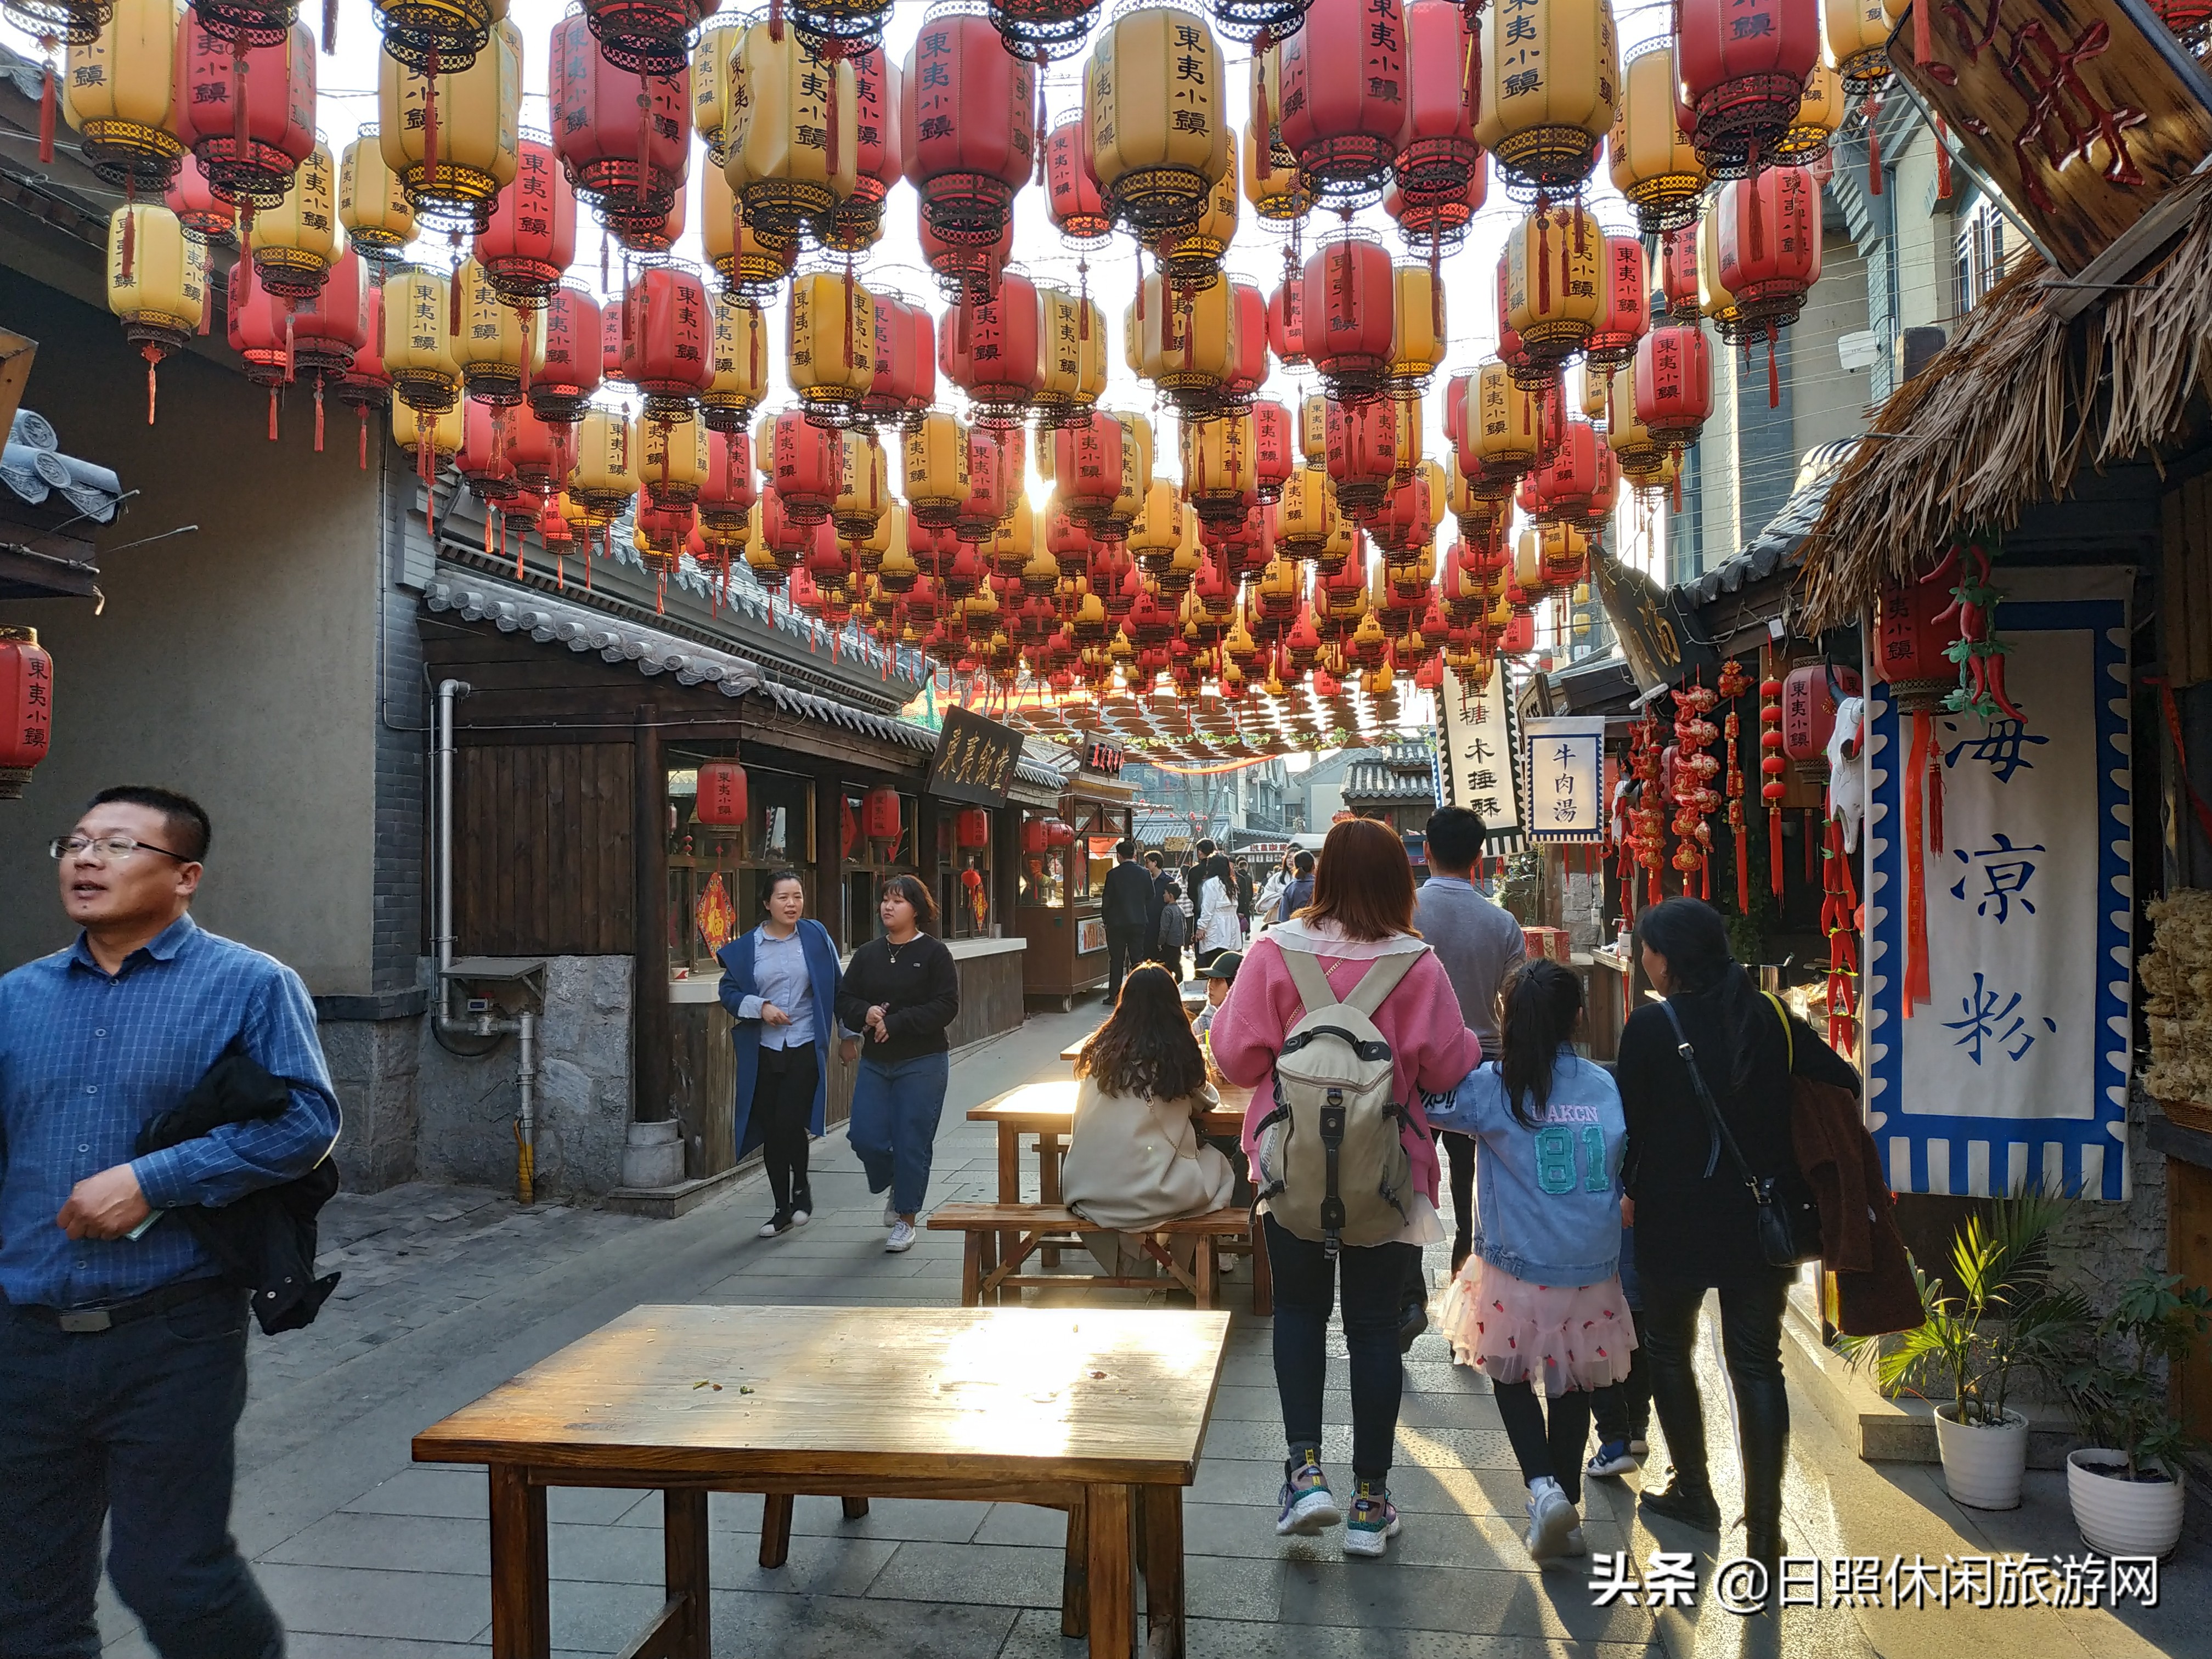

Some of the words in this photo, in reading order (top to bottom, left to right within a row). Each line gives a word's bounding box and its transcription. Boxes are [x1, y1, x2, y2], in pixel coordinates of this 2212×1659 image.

[697, 42, 715, 106] 東夷小鎮
[727, 53, 750, 161] 東夷小鎮
[919, 32, 955, 142] 東夷小鎮
[1172, 24, 1210, 138] 東夷小鎮
[302, 151, 332, 234] 東夷小鎮
[341, 154, 354, 211] 東夷小鎮
[518, 153, 550, 236] 東夷小鎮
[1053, 137, 1072, 197] 東夷小鎮
[1617, 247, 1640, 313] 東夷小鎮
[411, 285, 439, 352] 東夷小鎮
[545, 298, 572, 365] 東夷小鎮
[675, 286, 701, 362] 東夷小鎮
[792, 289, 811, 368] 東夷小鎮
[973, 297, 1002, 362] 夷小鎮
[1058, 304, 1079, 376] 東夷小鎮
[1657, 337, 1680, 400] 東夷小鎮
[1260, 410, 1278, 462] 東夷小鎮
[1311, 404, 1324, 442] 東夷小鎮
[1328, 401, 1343, 461] 東夷小鎮
[1485, 374, 1509, 436] 東夷小鎮
[778, 420, 796, 478] 東夷小鎮
[972, 445, 991, 500] 東夷小鎮
[1286, 472, 1304, 521] 東夷小鎮
[22, 658, 48, 748] 東夷小鎮
[1790, 680, 1809, 747] 東夷小鎮
[1846, 676, 1860, 693] 東
[717, 772, 732, 815] 東夷小鎮
[1553, 743, 1577, 824] 牛肉湯
[1535, 1124, 1609, 1195] 81
